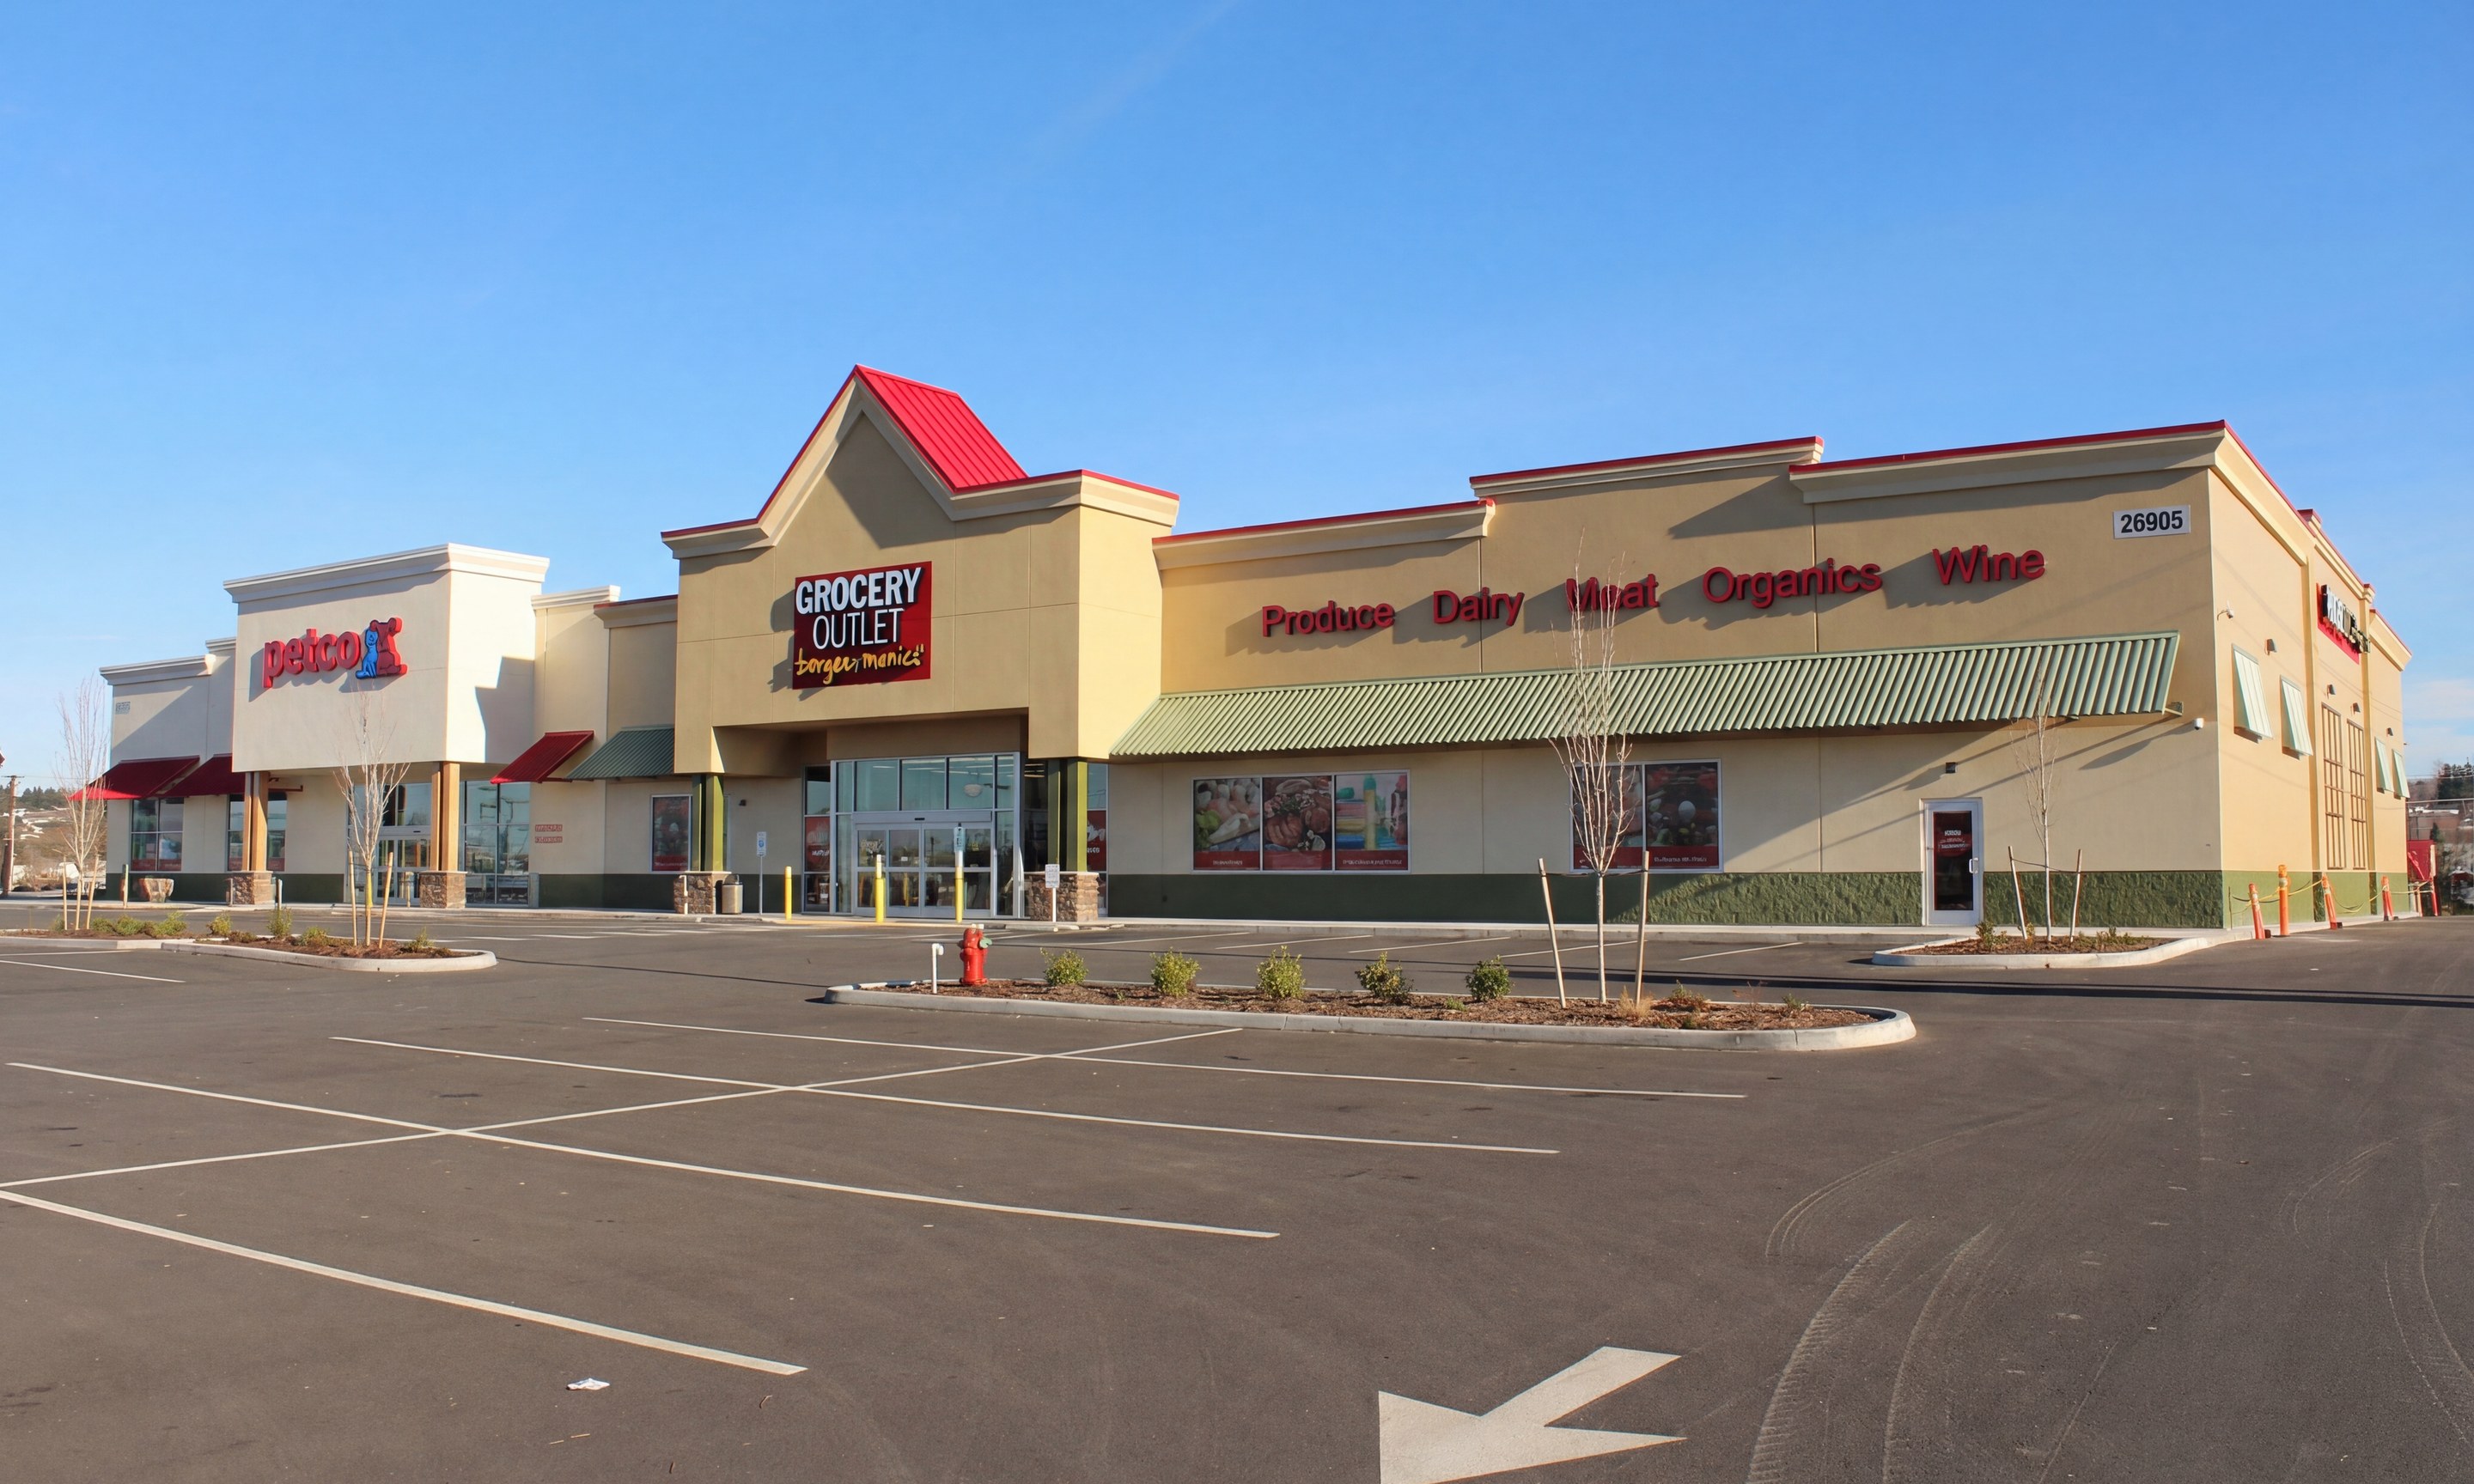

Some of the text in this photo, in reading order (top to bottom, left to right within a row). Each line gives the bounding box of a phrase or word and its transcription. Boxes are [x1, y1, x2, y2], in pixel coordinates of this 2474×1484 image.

[2120, 510, 2184, 533] 26905
[795, 567, 922, 614] GROCERY
[1262, 600, 1395, 637] Produce
[1434, 587, 1525, 626] Dairy
[1703, 558, 1883, 609] Organics
[1932, 544, 2045, 586] Wine
[813, 608, 905, 649] OUTLET
[263, 628, 361, 687] petco
